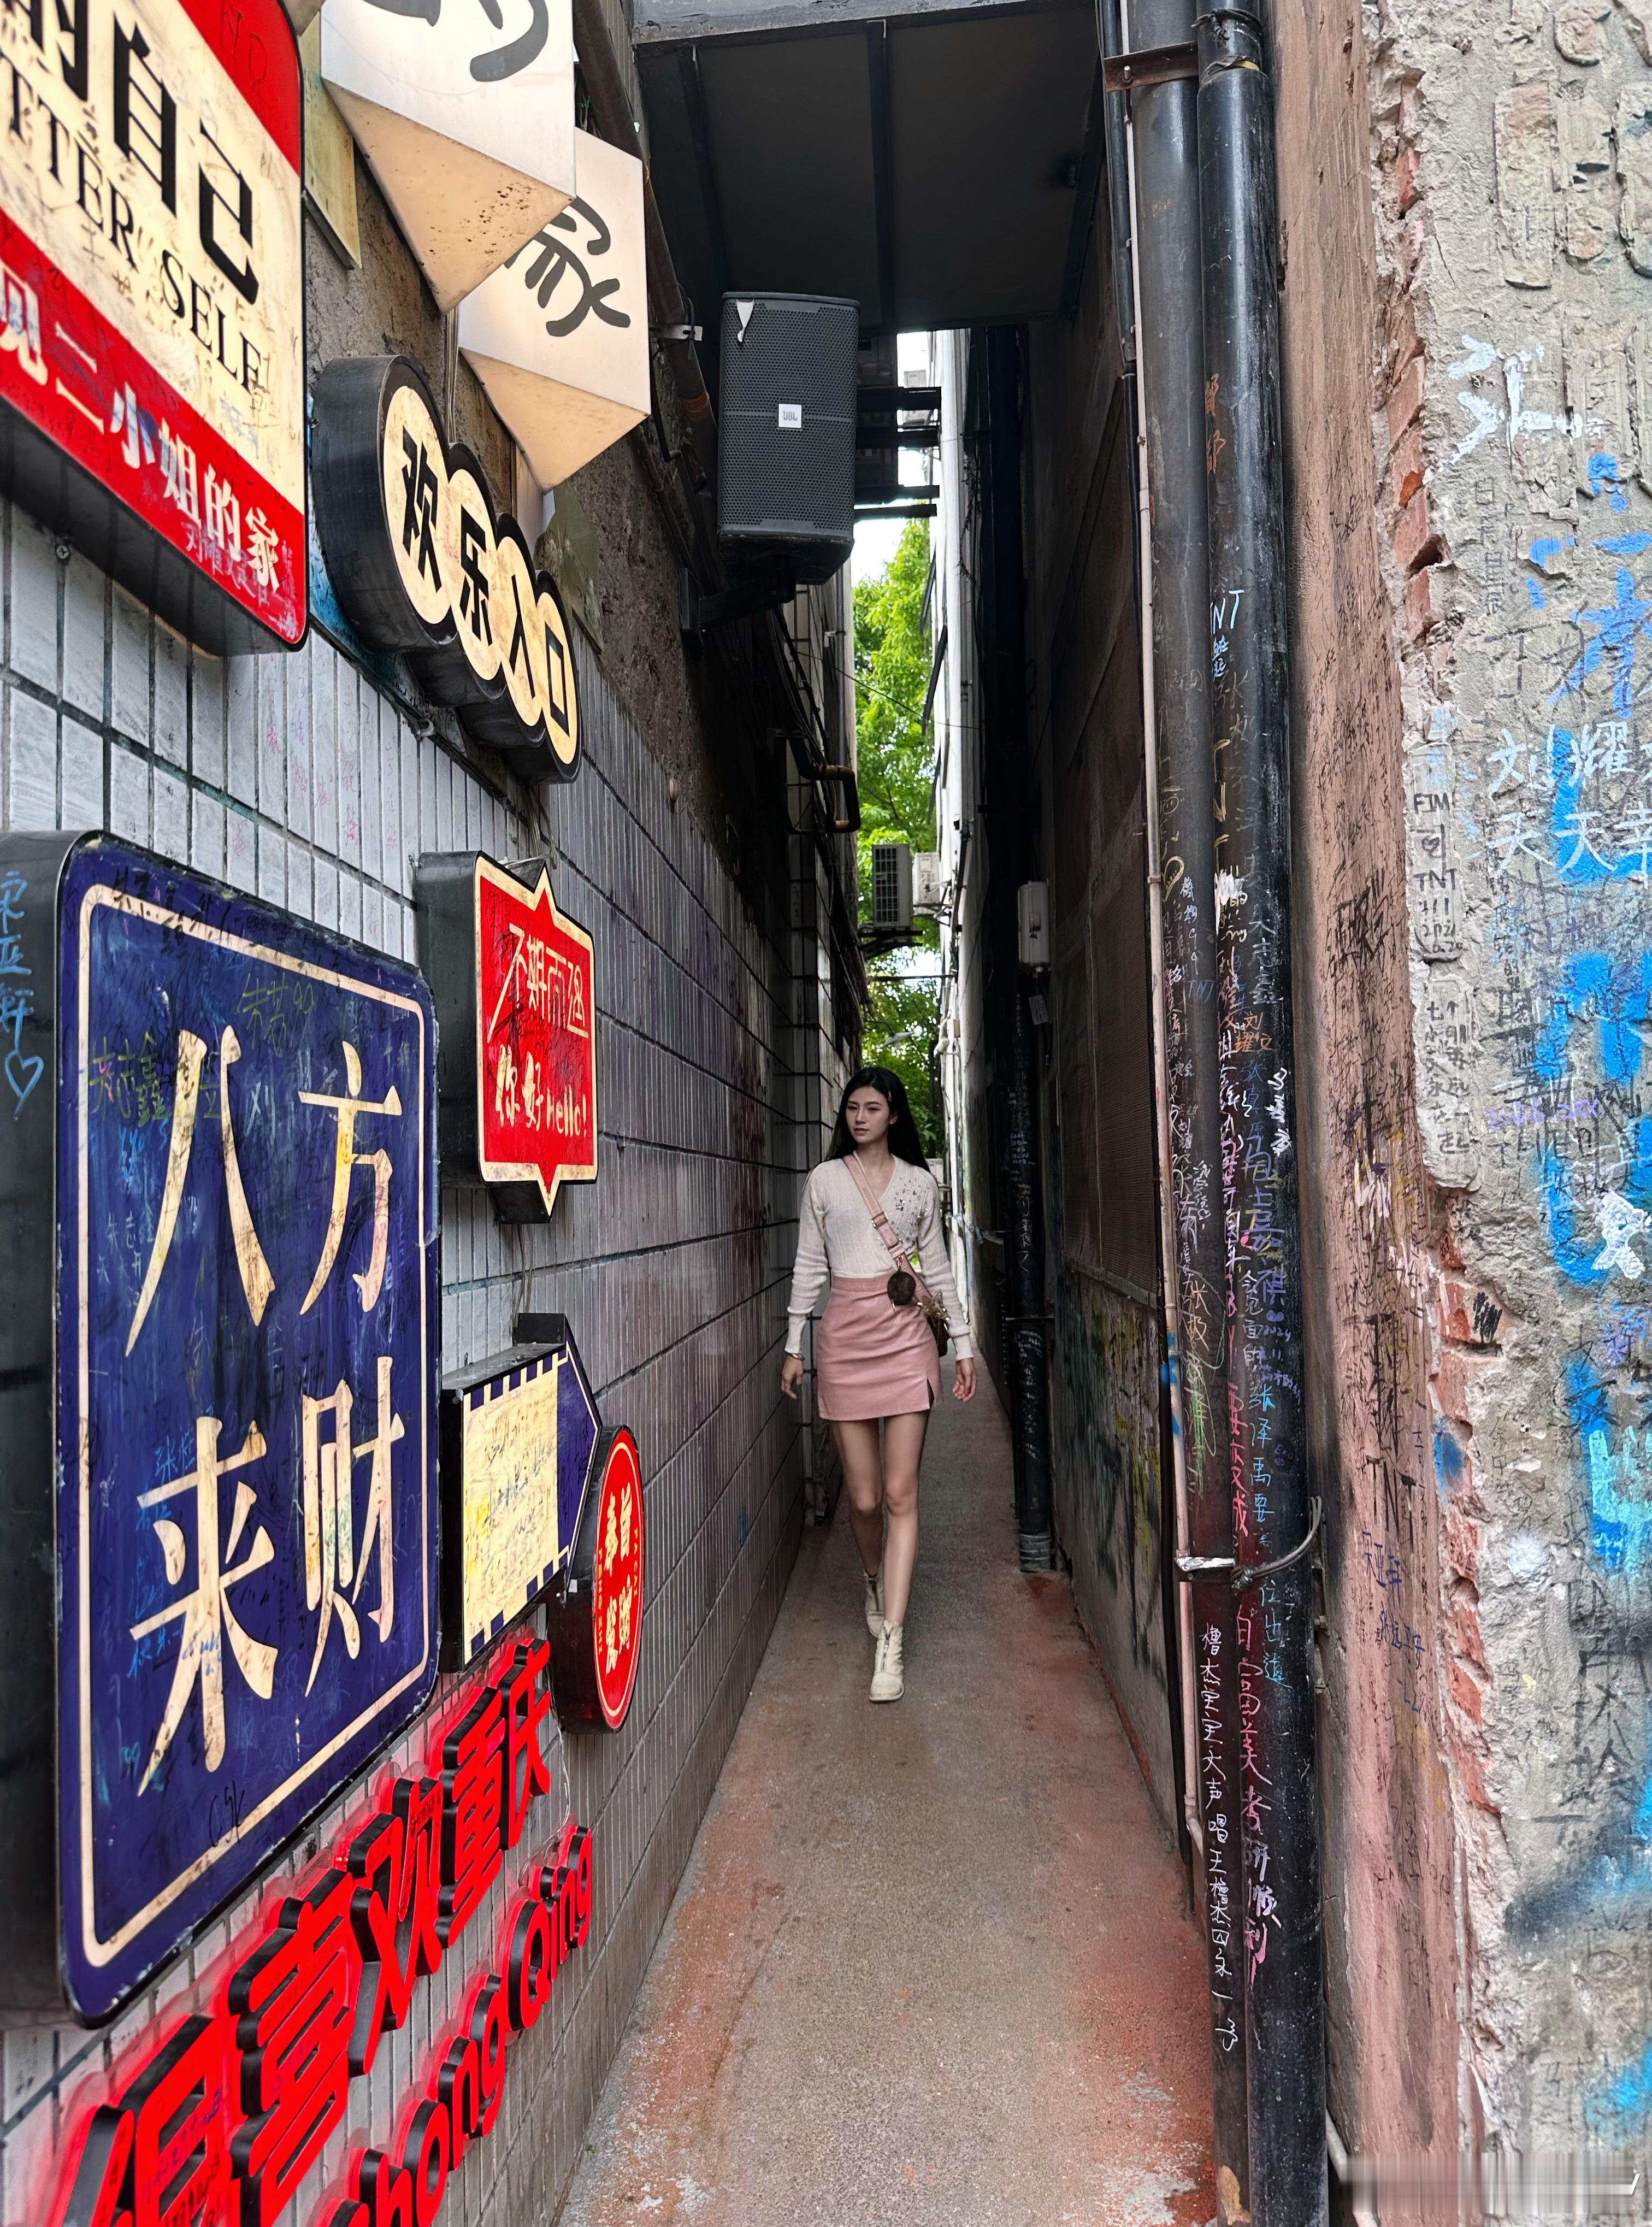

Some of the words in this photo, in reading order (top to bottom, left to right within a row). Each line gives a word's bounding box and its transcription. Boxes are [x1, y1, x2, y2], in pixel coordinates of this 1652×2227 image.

[161, 249, 262, 395] SELF
[782, 410, 798, 422] JBL
[402, 425, 571, 738] 欢乐入口
[1486, 722, 1652, 803] 刘耀
[487, 923, 589, 1044] 不期而遇
[495, 1043, 544, 1132] 你好
[546, 1084, 588, 1139] Hello!
[126, 1024, 403, 1357] 八方
[129, 1356, 405, 1798] 来财
[328, 1973, 505, 2227] hong
[508, 1825, 593, 2030] Qing
